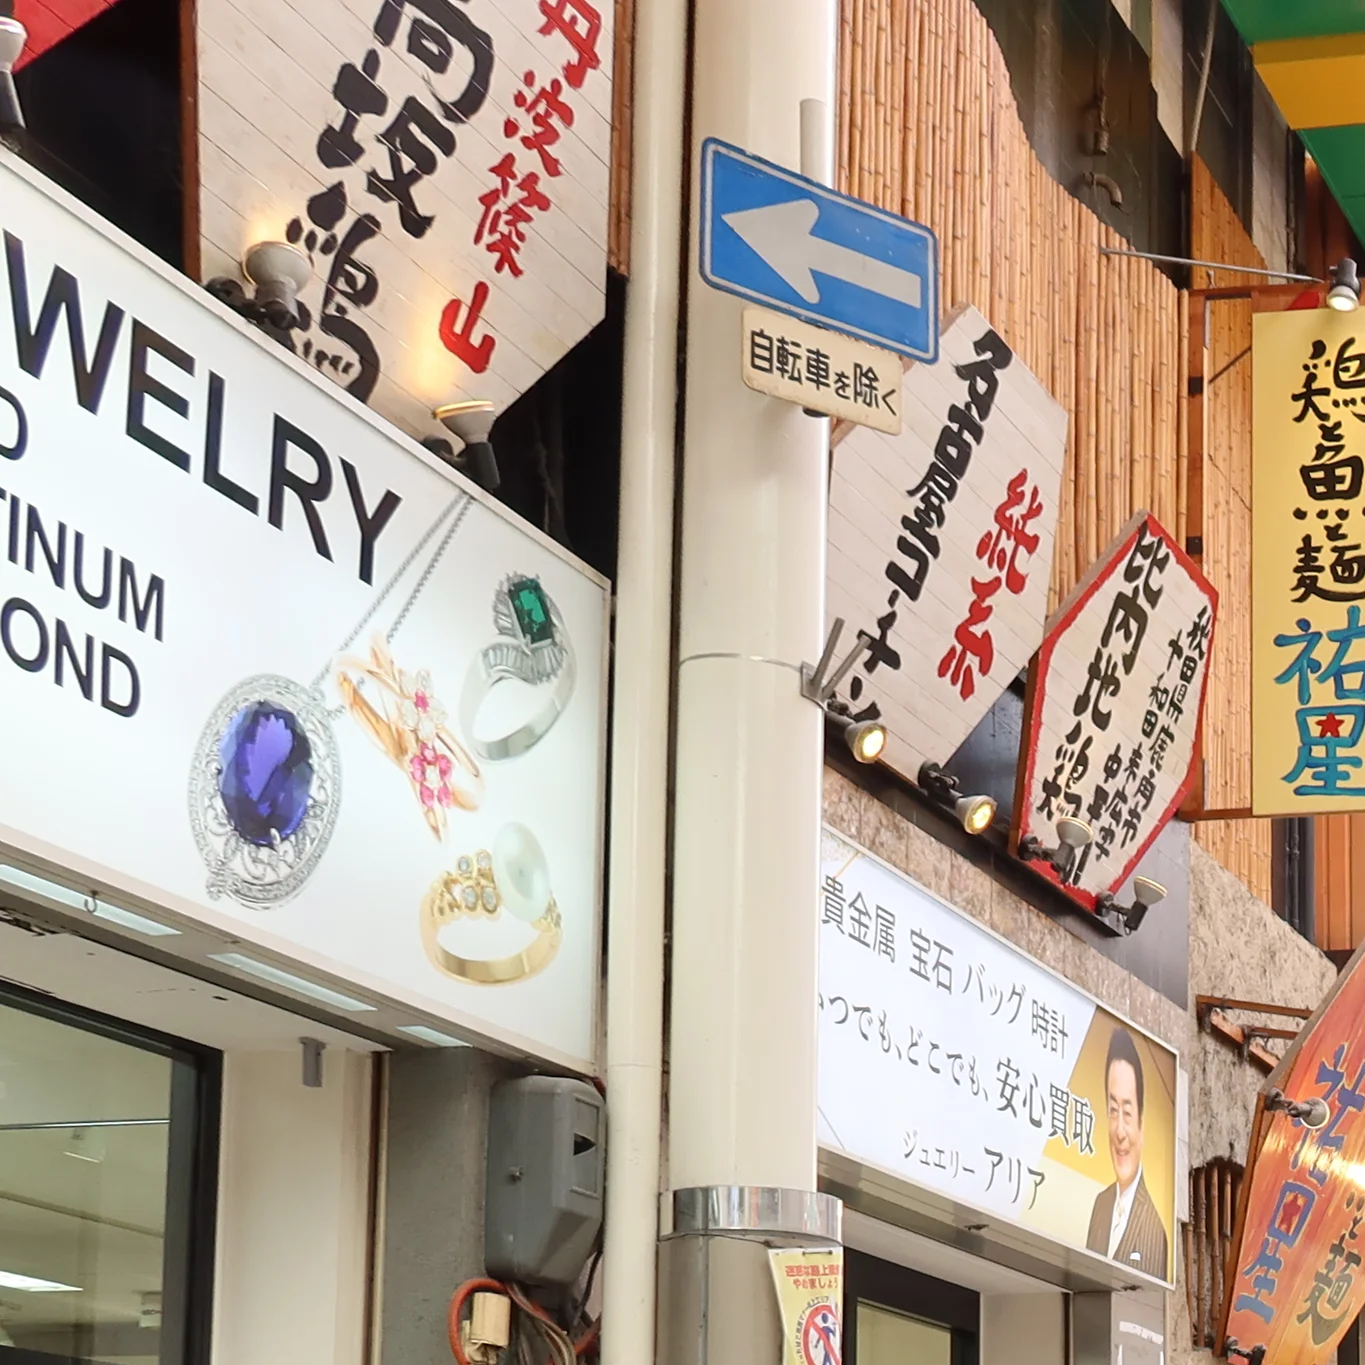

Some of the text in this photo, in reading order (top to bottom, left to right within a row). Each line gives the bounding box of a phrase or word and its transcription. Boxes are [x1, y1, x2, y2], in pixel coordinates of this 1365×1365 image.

[2, 228, 403, 588] WELRY
[749, 328, 898, 417] 自転車を除く
[0, 488, 165, 643] INUM
[0, 596, 141, 719] OND
[821, 875, 1069, 1060] 貴金属 宝石 バッグ 時計
[902, 1129, 1047, 1211] ジュエリー アリア
